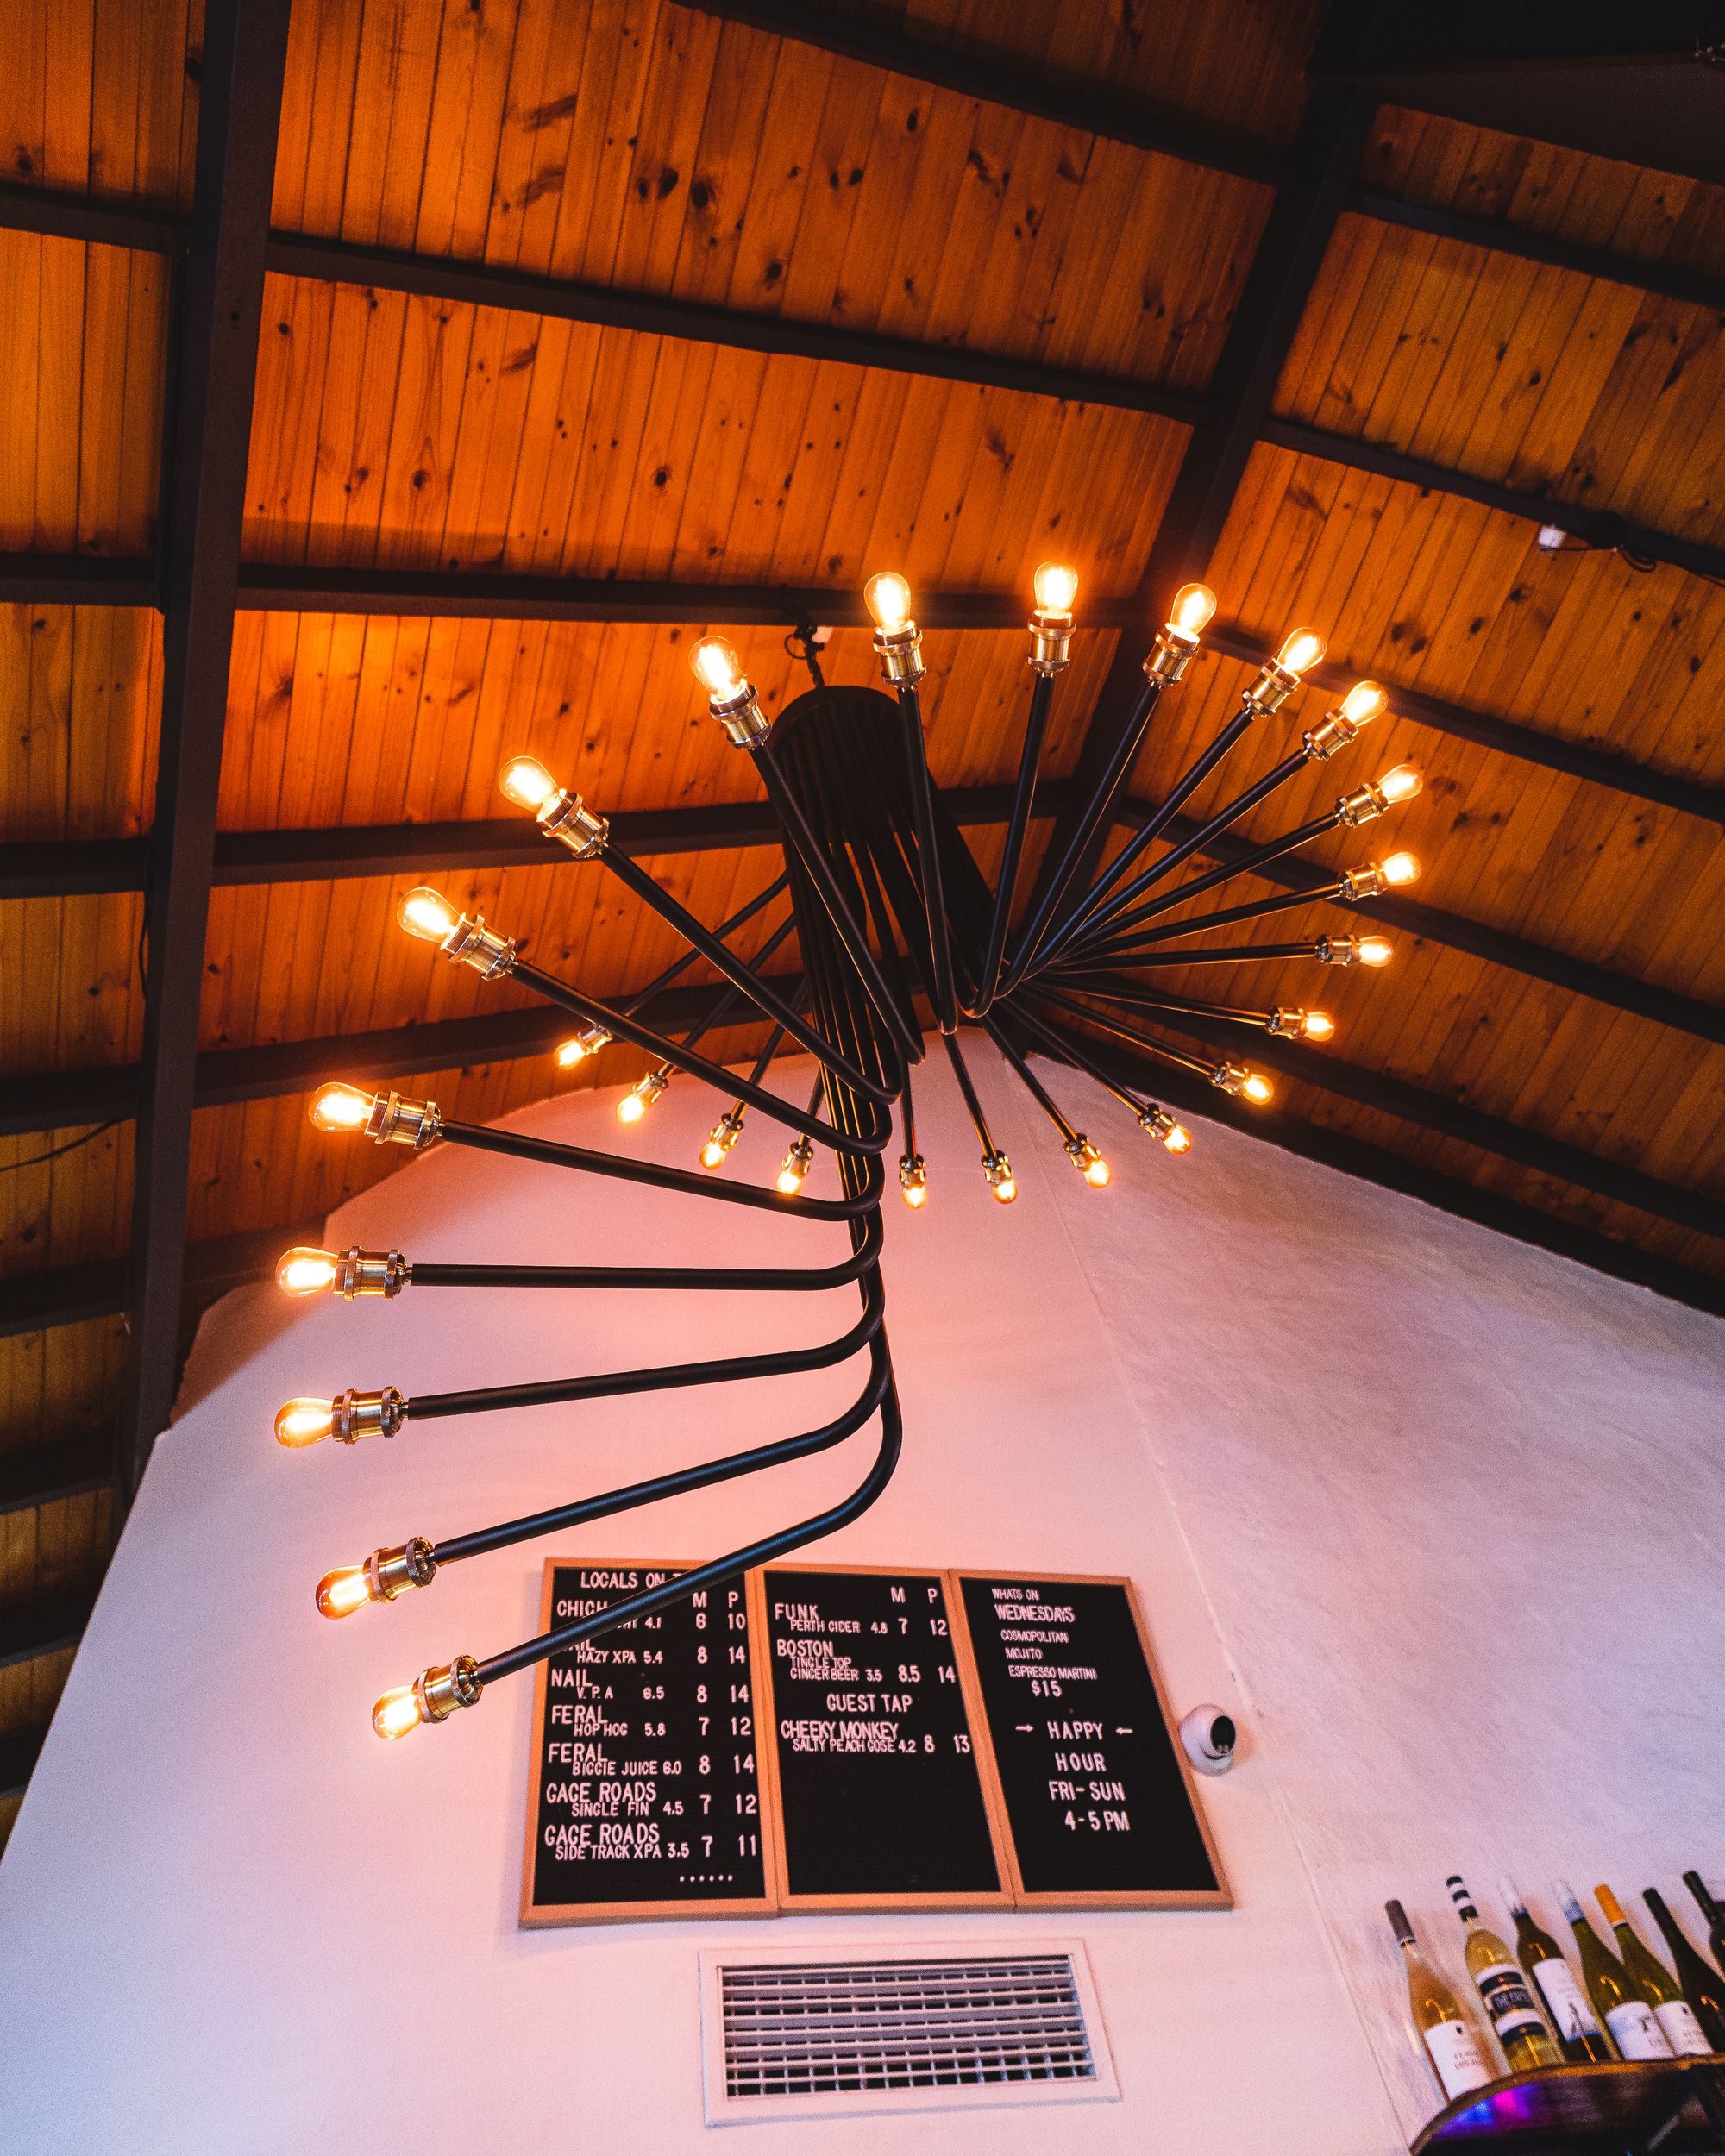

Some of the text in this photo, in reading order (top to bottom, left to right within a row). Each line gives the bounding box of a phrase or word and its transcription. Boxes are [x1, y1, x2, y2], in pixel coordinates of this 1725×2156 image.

[580, 1571, 666, 1589] LOCALS ON
[693, 1591, 739, 1608] M P
[890, 1586, 938, 1604] M P
[992, 1588, 1040, 1601] WHATS ON
[775, 1602, 820, 1621] FUNK
[994, 1604, 1076, 1623] WEDNESDAYS
[728, 1613, 746, 1630] 10
[790, 1618, 948, 1636] PERTH CIDER 4.8 7 12
[1000, 1629, 1070, 1644] COSMOPOLITAN
[576, 1646, 745, 1664] HAZY XPA 5.4 8 14
[776, 1639, 834, 1658] BOSTON
[1005, 1647, 1044, 1660] MOJITO
[789, 1656, 852, 1669] TINGLE TOP
[551, 1669, 593, 1687] NAIL
[790, 1664, 956, 1683] GINGER BEER 3.5 8.5 14
[1007, 1664, 1098, 1681] ESPRESSO MARTINI
[643, 1685, 665, 1700] 6.5
[697, 1685, 707, 1702] 8
[731, 1685, 749, 1703] 14
[1031, 1680, 1063, 1698] $15
[826, 1693, 913, 1713] GUEST TAP
[551, 1705, 608, 1725] FERAL
[574, 1717, 751, 1737] HOP HOG 5.8 7 12
[781, 1720, 899, 1740] CHEEKY MONKEY
[1046, 1720, 1103, 1740] HAPPY
[548, 1742, 608, 1763] FERAL
[792, 1734, 971, 1754] SALTY PEACH GOSE 4.2 8 13
[572, 1754, 754, 1776] BIGGIE JUICE 6.0 8 14
[1054, 1752, 1107, 1772] HOUR
[546, 1782, 657, 1804] GAGE ROADS
[571, 1794, 756, 1817] SINGLE FIN 4.5 7 12
[544, 1823, 661, 1846] GAGE ROADS
[555, 1834, 756, 1860] SIDE TRACK XPA 3.5 7 11
